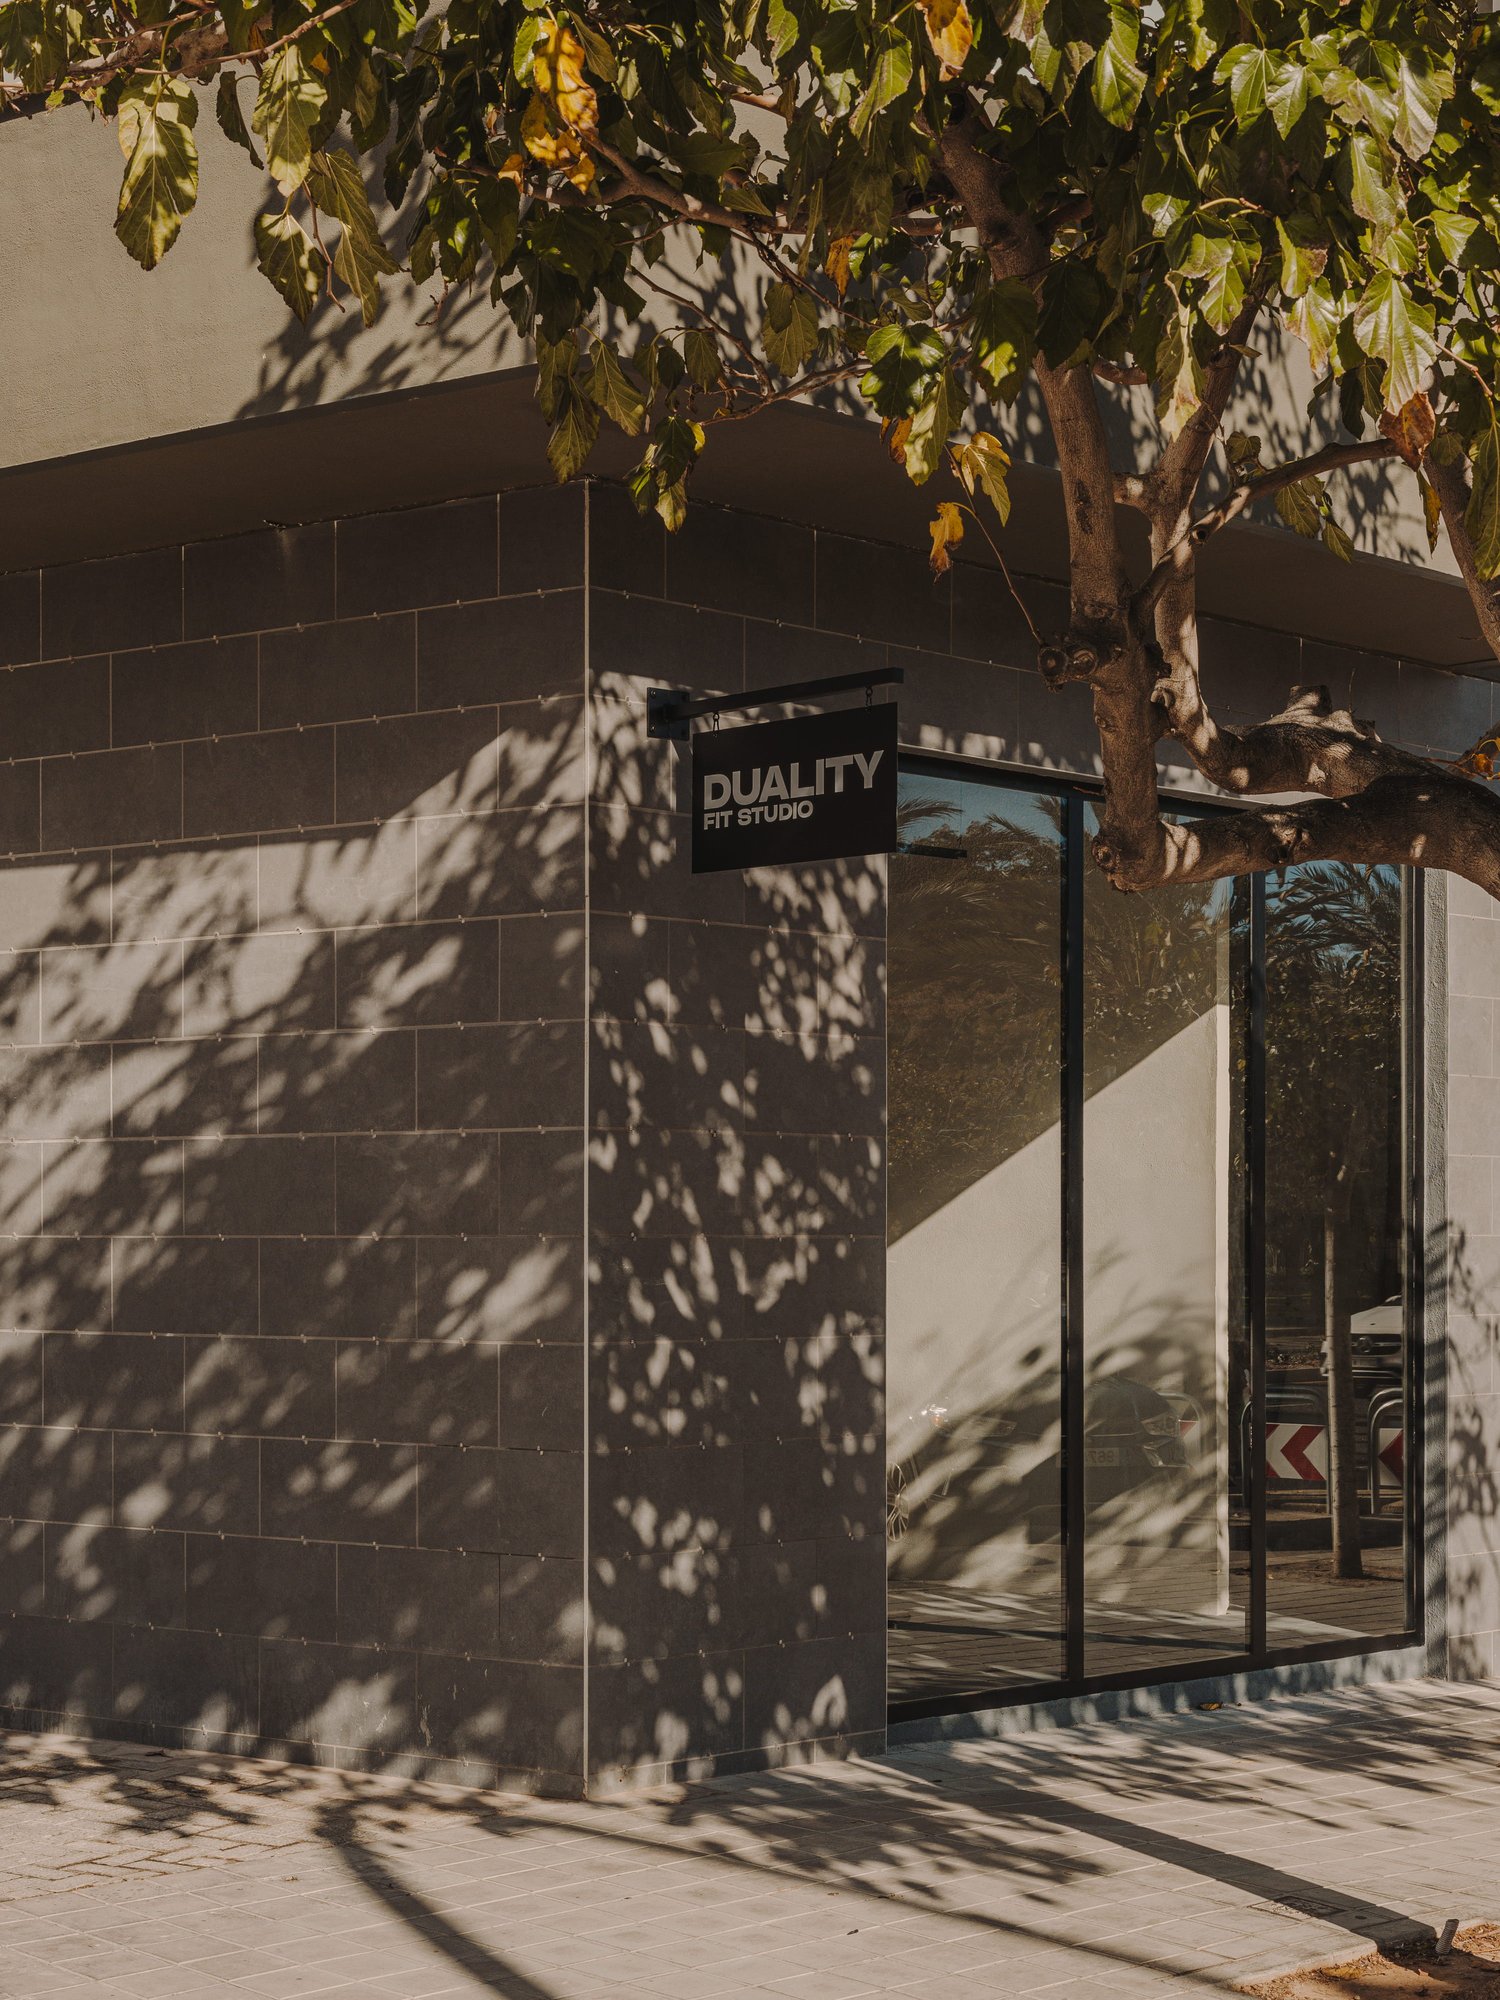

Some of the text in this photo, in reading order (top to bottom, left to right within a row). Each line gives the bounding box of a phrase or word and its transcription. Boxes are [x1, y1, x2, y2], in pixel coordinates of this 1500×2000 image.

[704, 750, 885, 811] DUALITY
[704, 801, 815, 831] FIT STUDIO
